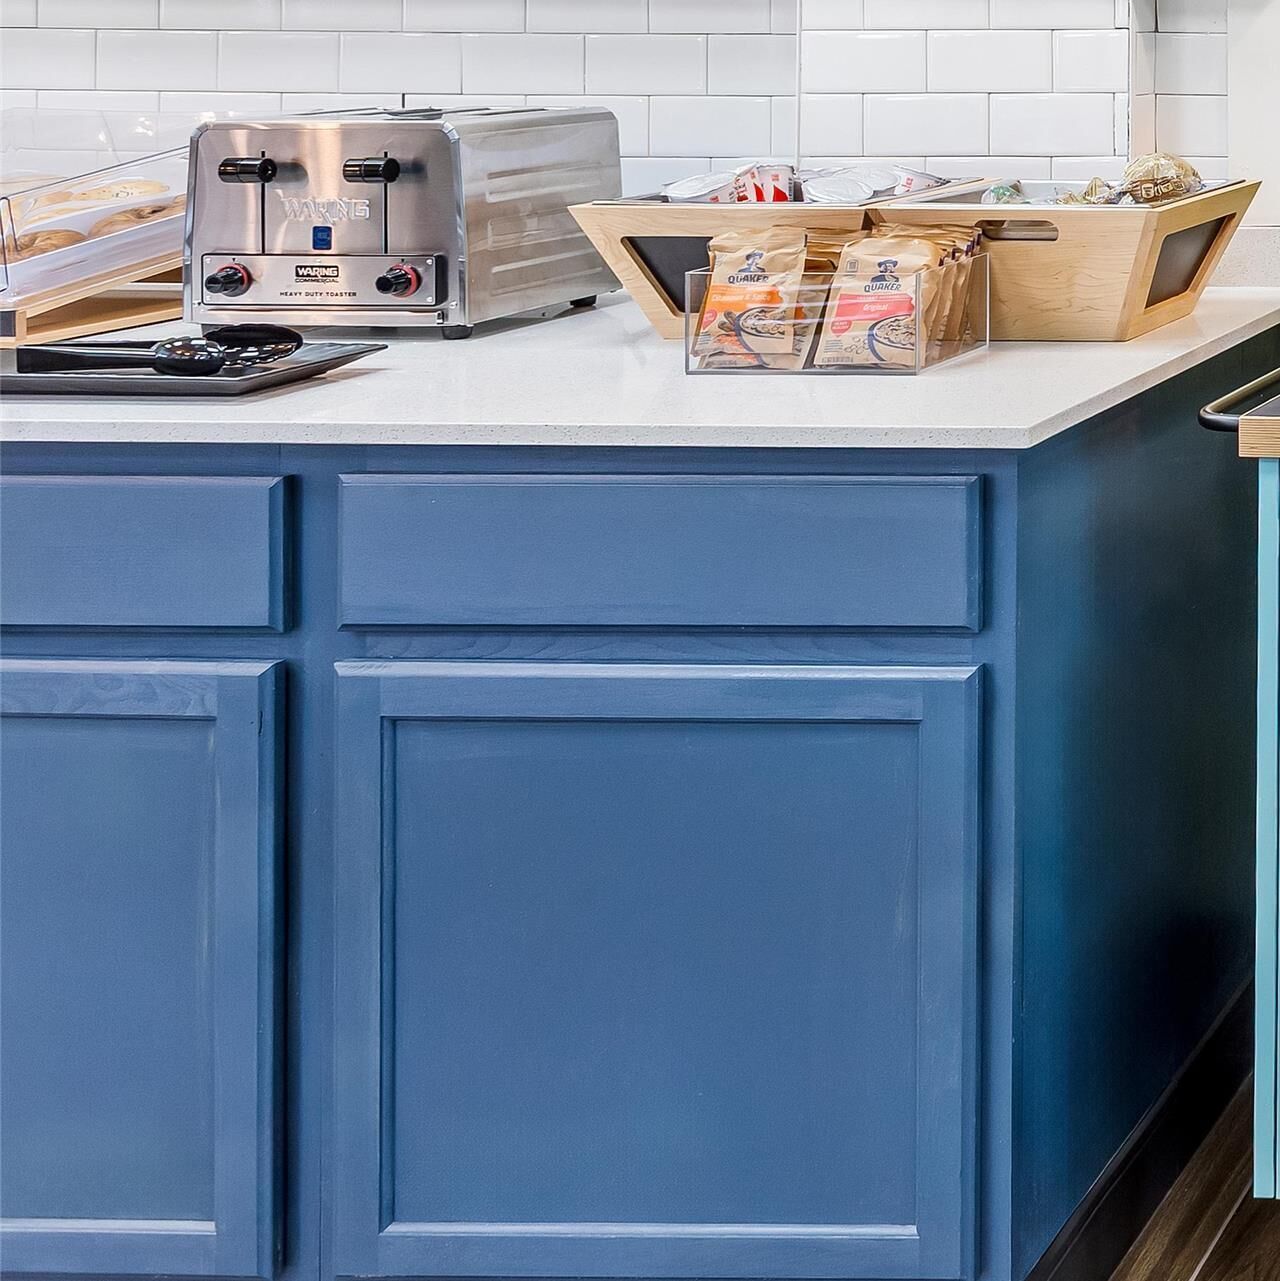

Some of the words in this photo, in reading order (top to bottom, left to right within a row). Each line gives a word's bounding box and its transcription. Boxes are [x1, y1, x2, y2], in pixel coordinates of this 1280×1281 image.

[297, 266, 339, 278] WARING
[728, 274, 769, 284] QUAKER
[864, 282, 901, 293] QUAKER
